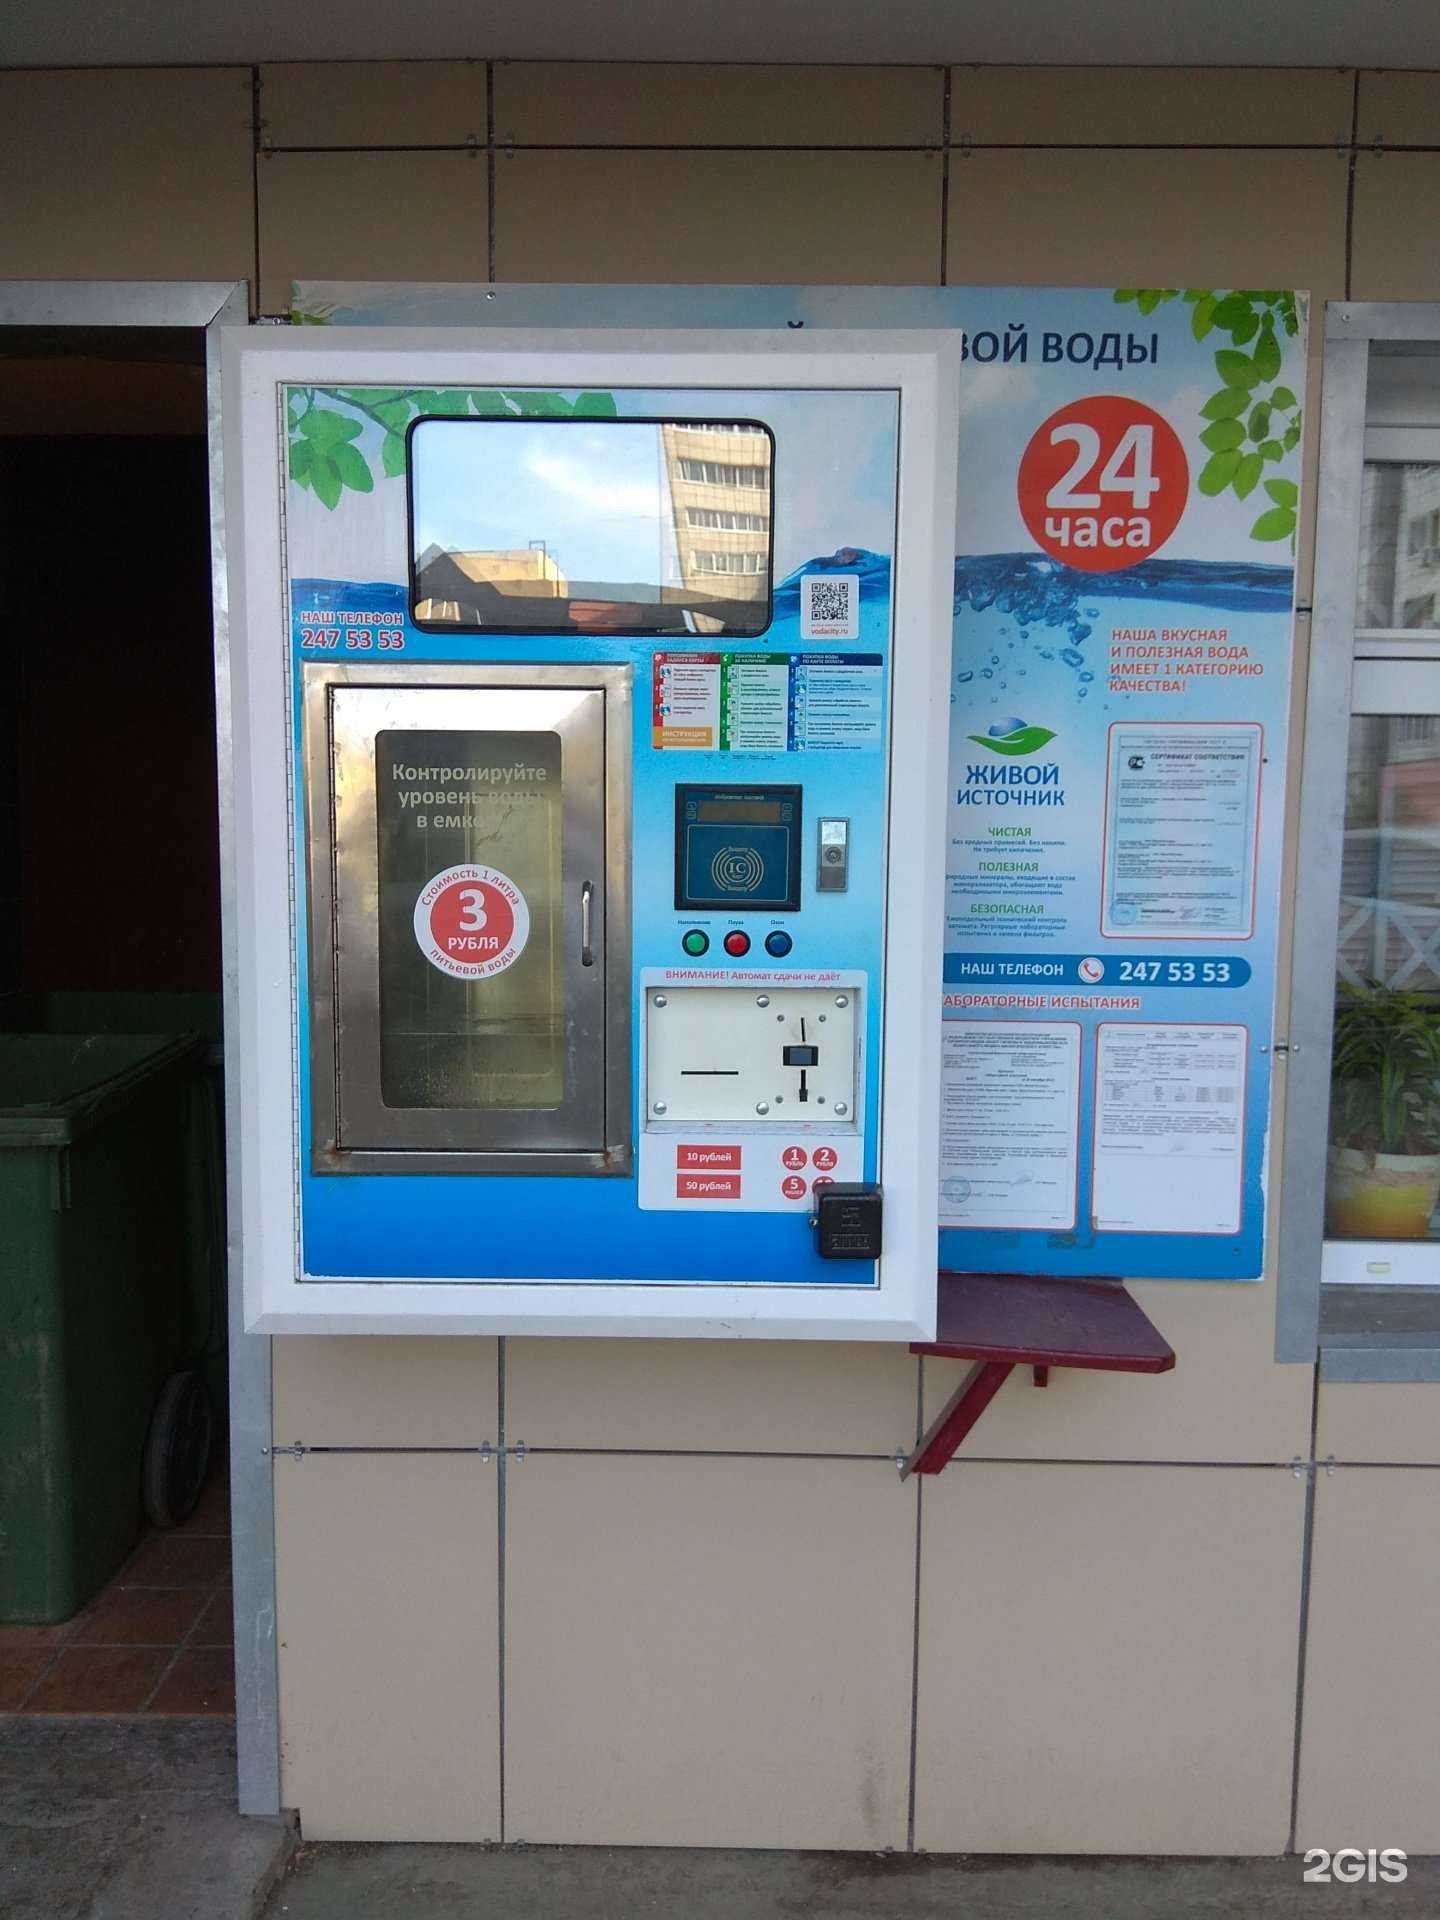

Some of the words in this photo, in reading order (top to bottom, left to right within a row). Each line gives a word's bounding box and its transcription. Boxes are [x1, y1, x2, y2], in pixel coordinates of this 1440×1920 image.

[1042, 332, 1159, 371] ВОДЫ
[1046, 422, 1161, 510] 24
[1045, 516, 1152, 548] часа
[301, 611, 334, 624] НАШ
[338, 611, 404, 625] ТЕЛЕФОН
[301, 629, 340, 648] 247
[346, 630, 371, 648] 53
[378, 630, 404, 649] 53
[1112, 629, 1157, 641] НАША
[1161, 630, 1228, 642] ВКУСНАЯ
[1111, 646, 1121, 658] И
[1126, 646, 1203, 658] ПОЛЕЗНАЯ
[1208, 647, 1249, 660] ВОДА
[1110, 663, 1159, 675] ИМЕЕТ
[1164, 664, 1171, 675] 1
[1176, 664, 1264, 675] КАТЕГОРИЮ
[1109, 680, 1186, 692] КАЧЕСТВА!
[392, 763, 547, 784] Контролируйте
[966, 763, 1060, 785] ЖИВОЙ
[398, 790, 481, 808] уровень
[957, 789, 1065, 806] ИСТОЧНИК
[416, 816, 428, 828] в
[988, 827, 1032, 837] ЧИСТАЯ
[978, 862, 1039, 872] ПОЛЕЗНАЯ
[421, 869, 479, 907] Стоимость
[482, 870, 489, 880] 1
[491, 873, 521, 906] литра
[459, 888, 488, 932] 3
[970, 904, 1044, 914] БЕЗОПАСНАЯ
[448, 936, 499, 950] РУБЛЯ
[430, 949, 486, 976] питьевой
[488, 948, 517, 972] воды
[665, 970, 728, 980] ВНИМАНИЕ!
[731, 971, 771, 981] Автомат
[960, 962, 995, 975] НАШ
[998, 963, 1064, 977] ТЕЛЕФОН
[1119, 961, 1161, 982] 247
[1167, 962, 1196, 982] 53
[1202, 962, 1231, 983] 53
[943, 995, 1047, 1007] АБОРАТОРНЫЕ
[1051, 996, 1141, 1009] ИСПЫТАНИЯ
[686, 1152, 698, 1161] 10
[699, 1151, 732, 1163] рублей
[791, 1149, 800, 1160] 1
[820, 1149, 830, 1161] 2
[686, 1182, 698, 1190] 50
[699, 1180, 732, 1192] рублей
[790, 1178, 799, 1190] 5
